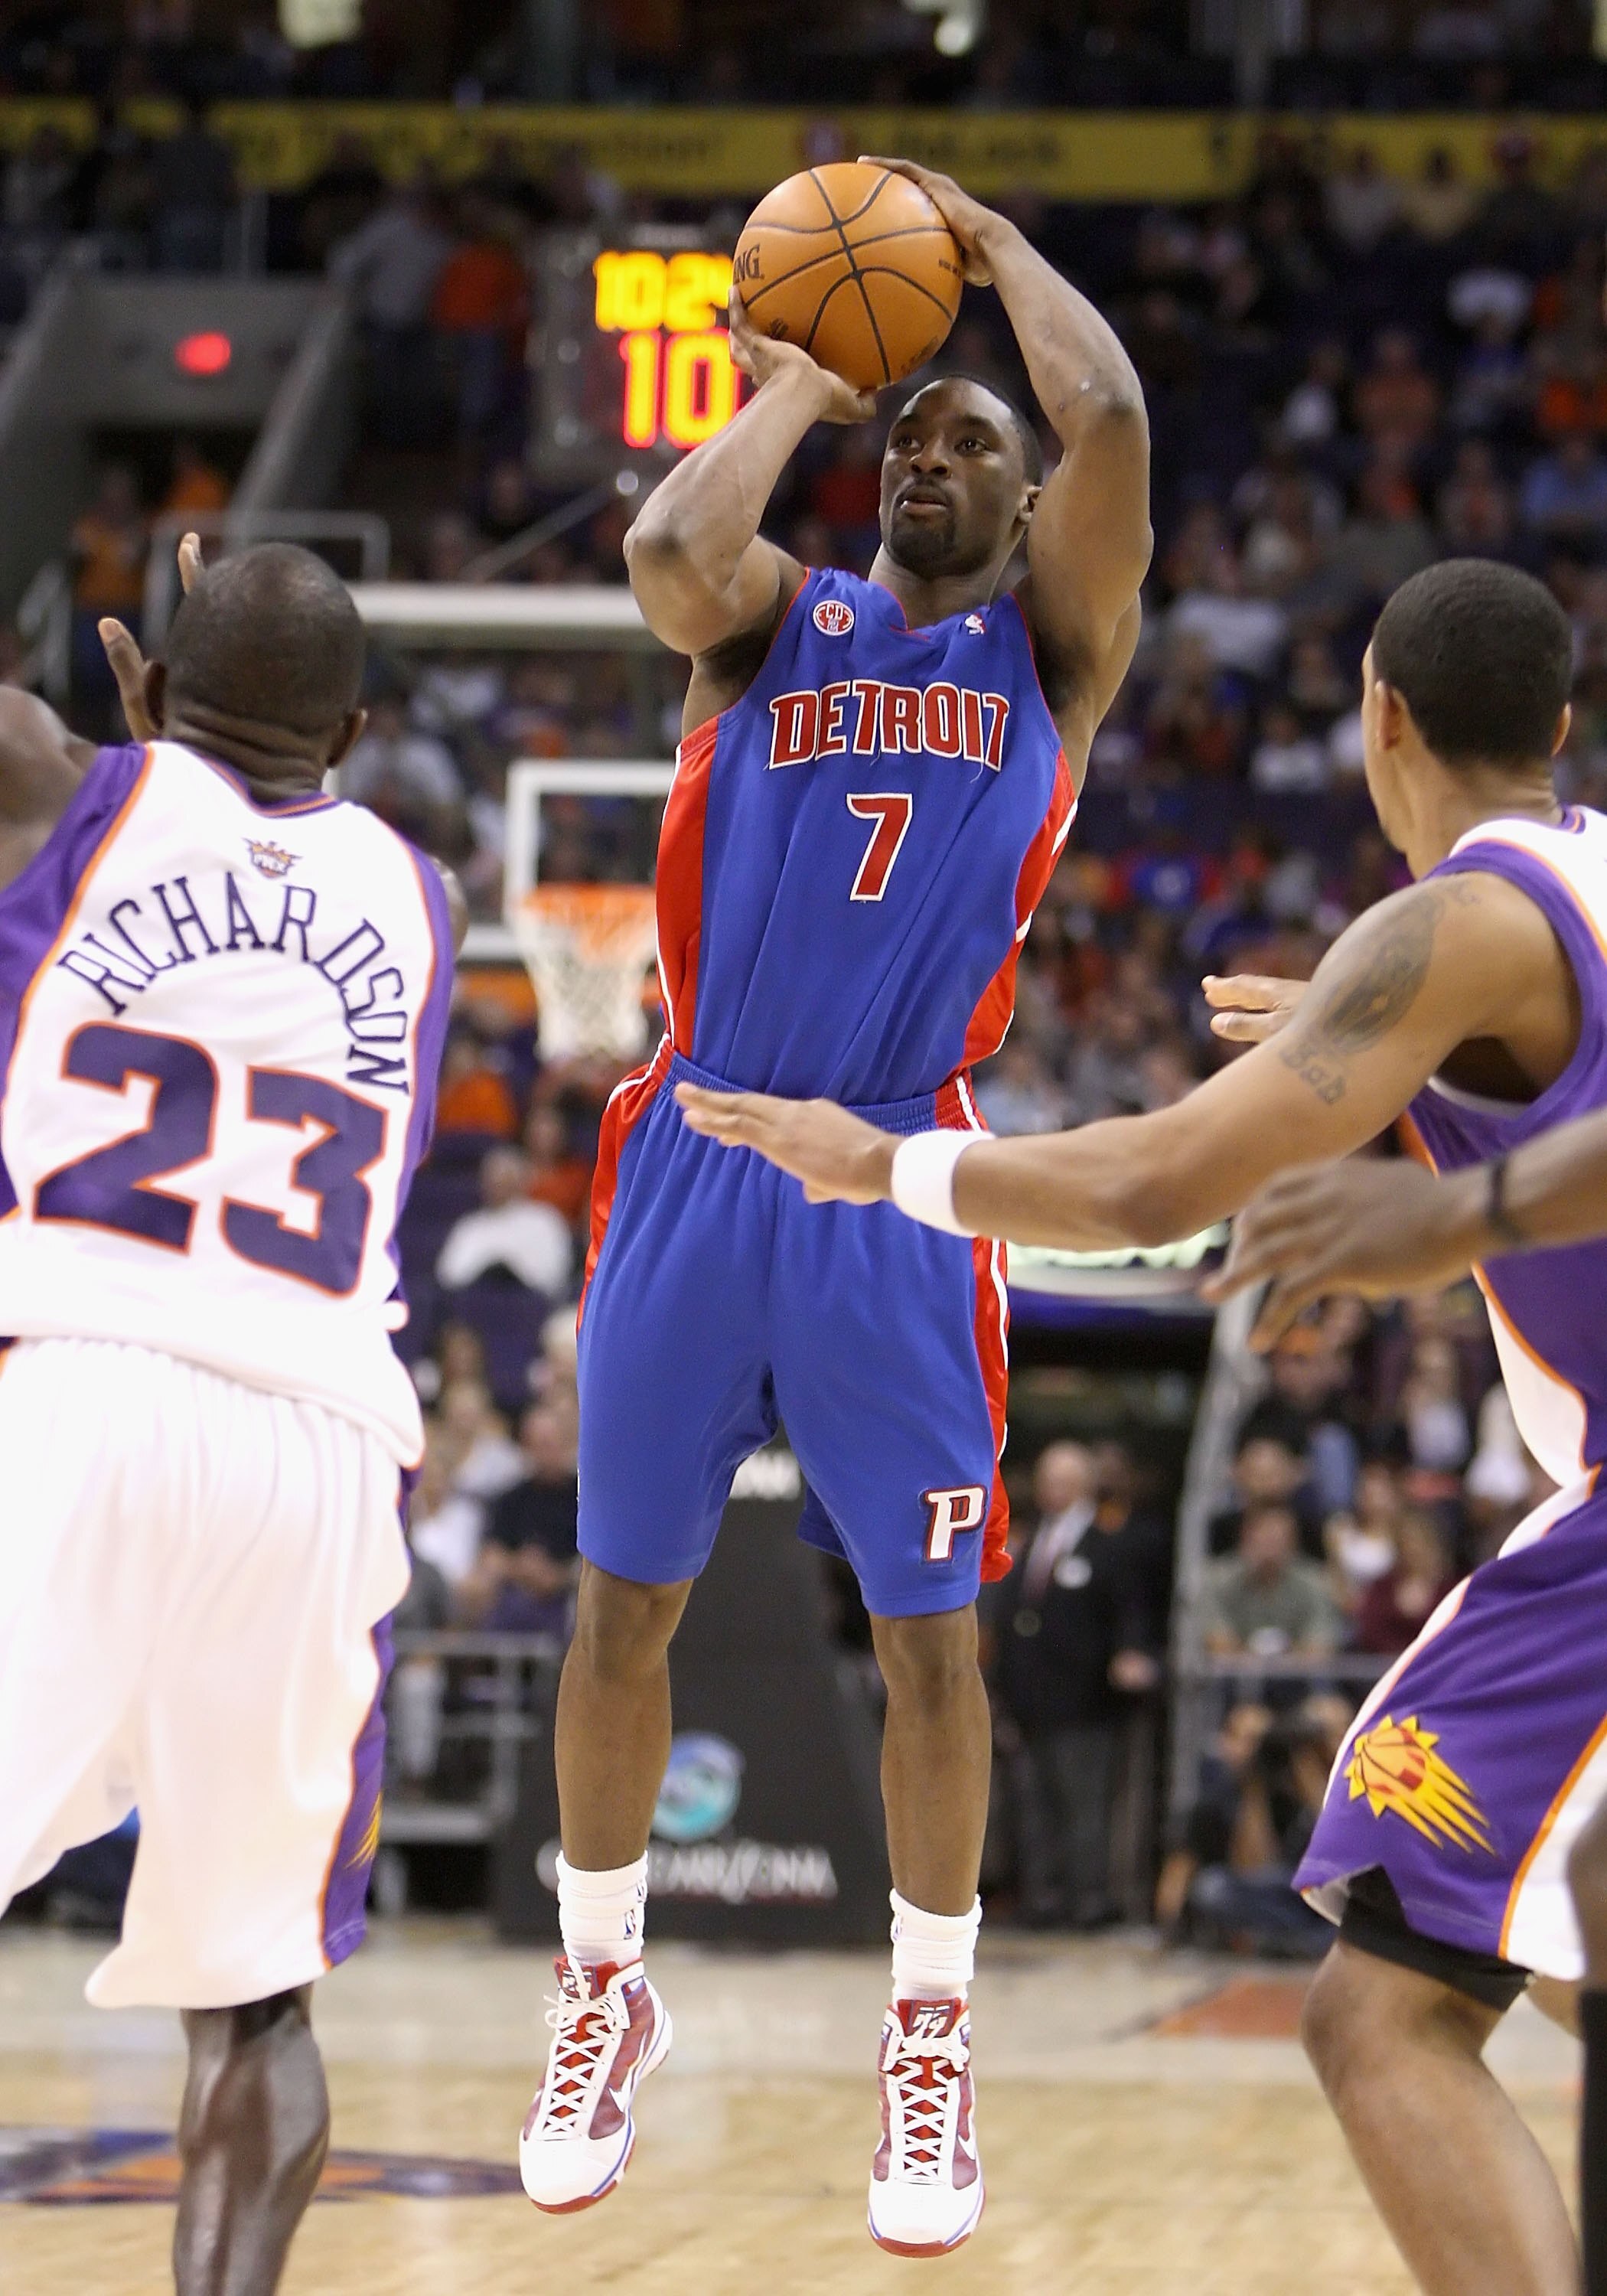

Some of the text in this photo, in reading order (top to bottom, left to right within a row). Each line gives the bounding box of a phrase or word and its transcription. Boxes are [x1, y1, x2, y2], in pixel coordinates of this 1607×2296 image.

[618, 328, 740, 448] 10
[769, 679, 1010, 772] DETROIT
[846, 793, 913, 902] 7
[57, 871, 410, 1096] RICHARDSON
[32, 1019, 389, 1298] 23
[924, 1484, 986, 1562] P
